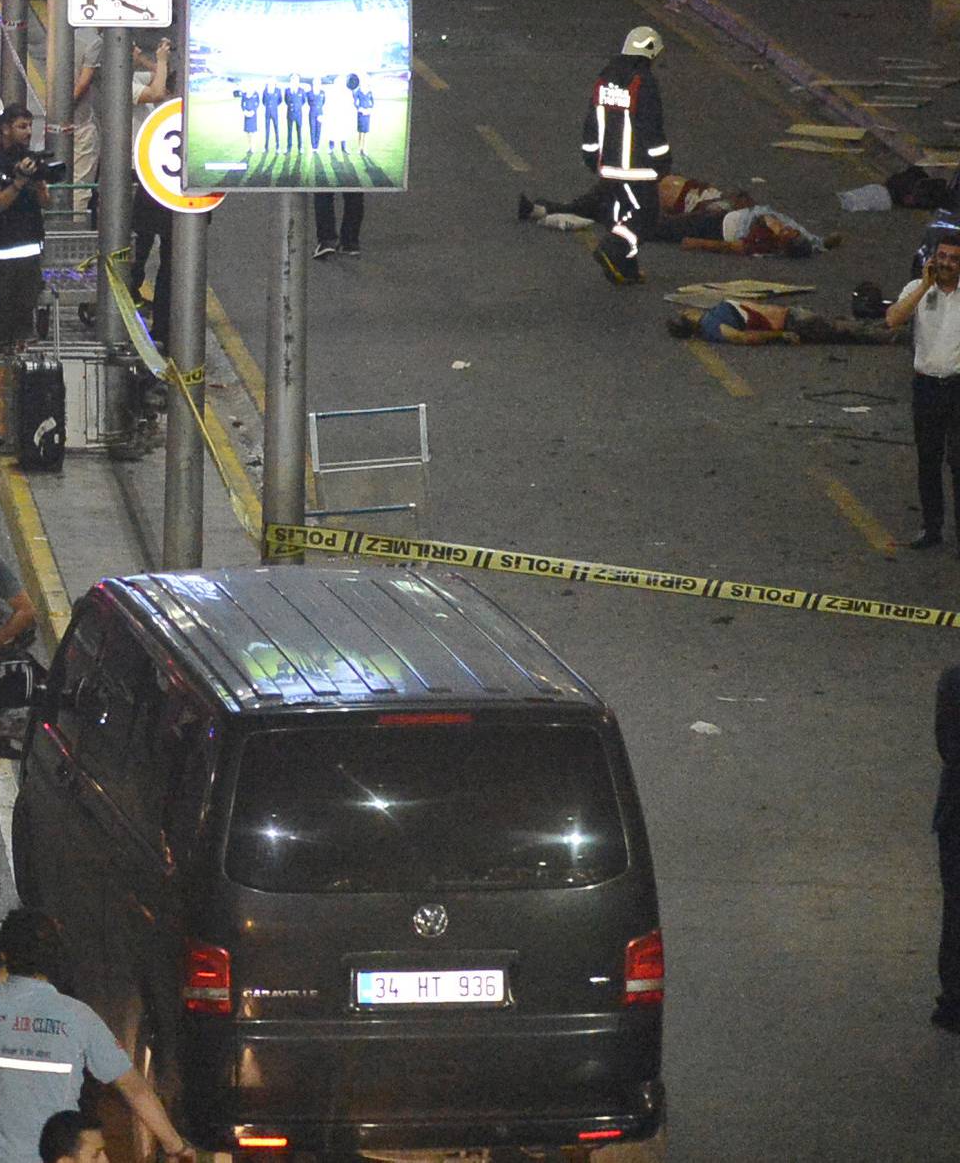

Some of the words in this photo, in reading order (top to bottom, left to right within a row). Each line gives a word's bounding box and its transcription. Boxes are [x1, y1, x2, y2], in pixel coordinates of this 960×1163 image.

[376, 977, 398, 998] 34
[418, 976, 441, 997] HT
[459, 975, 496, 997] 936
